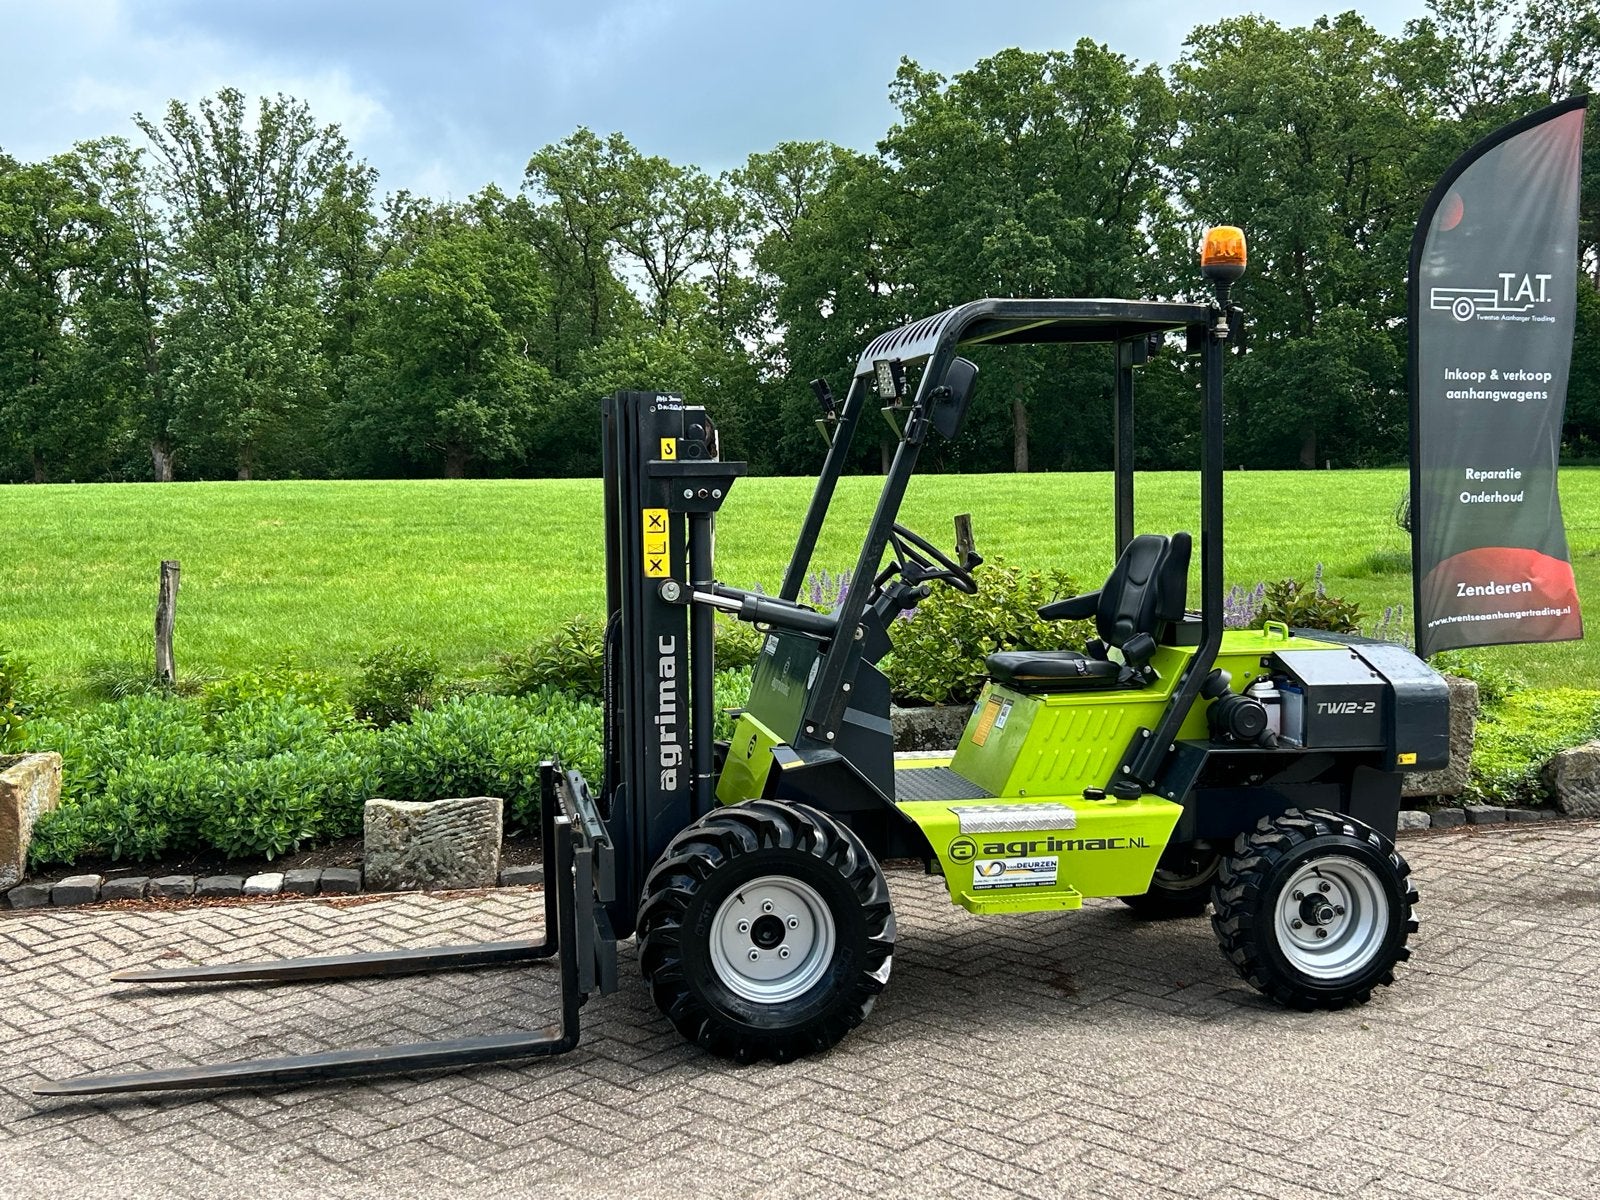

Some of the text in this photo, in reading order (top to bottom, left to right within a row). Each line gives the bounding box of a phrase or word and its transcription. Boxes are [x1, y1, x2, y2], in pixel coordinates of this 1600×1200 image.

[1499, 273, 1552, 302] T.A.T.
[1501, 314, 1530, 322] Aanhanger
[1532, 315, 1556, 323] Trading
[1444, 368, 1552, 384] Inkoop & verkoop
[1446, 387, 1548, 402] aanhangwagens
[1465, 468, 1522, 482] Reparatie
[1459, 491, 1524, 503] Onderhoud
[1456, 581, 1532, 597] Zenderen
[1427, 606, 1571, 628] www.twentseaanhangertrading.nl
[654, 635, 682, 791] agrimac
[1316, 702, 1376, 714] TW12-2
